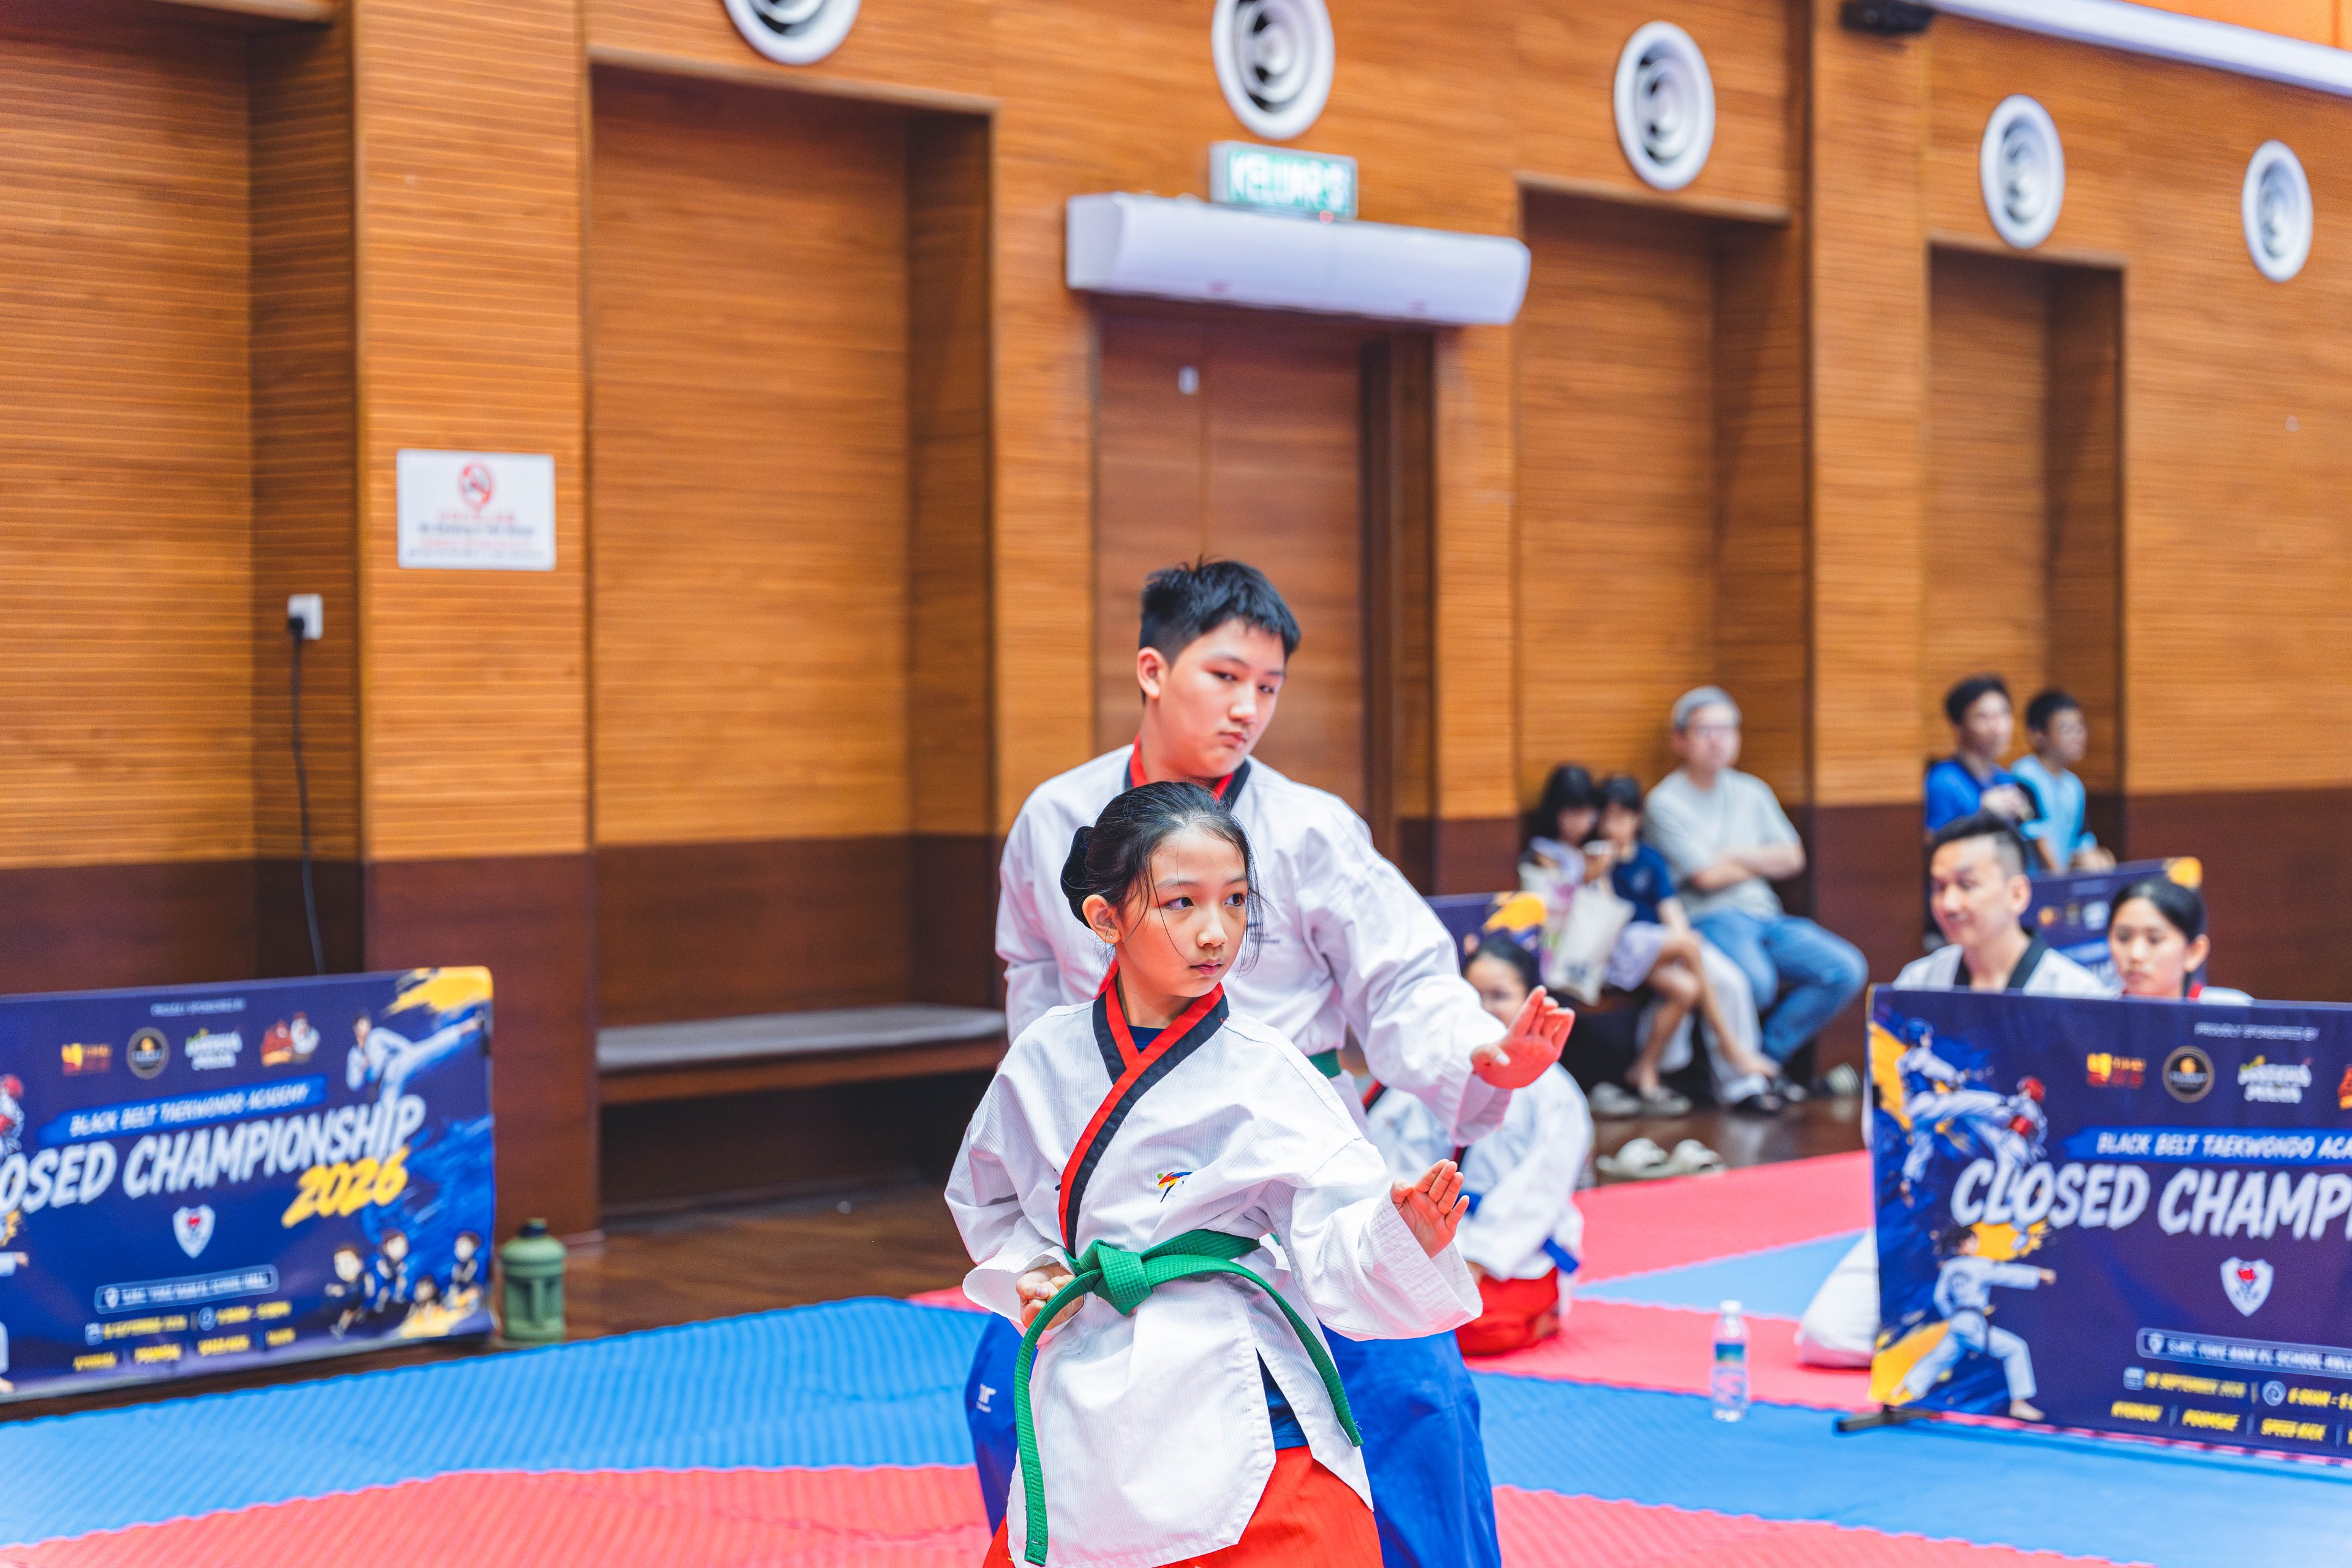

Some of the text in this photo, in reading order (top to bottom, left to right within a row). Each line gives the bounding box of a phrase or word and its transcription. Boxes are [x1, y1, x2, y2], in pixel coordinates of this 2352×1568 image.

[69, 1109, 118, 1138] BLACK
[120, 1103, 159, 1131] BELT
[123, 1094, 428, 1200] CHAMPIONSHIP
[2096, 1132, 2152, 1156] BLACK
[2154, 1133, 2199, 1156] BELT
[2203, 1134, 2316, 1159] TAEKWONDO
[281, 1143, 410, 1229] 2026
[1950, 1157, 2151, 1231] CLOSED
